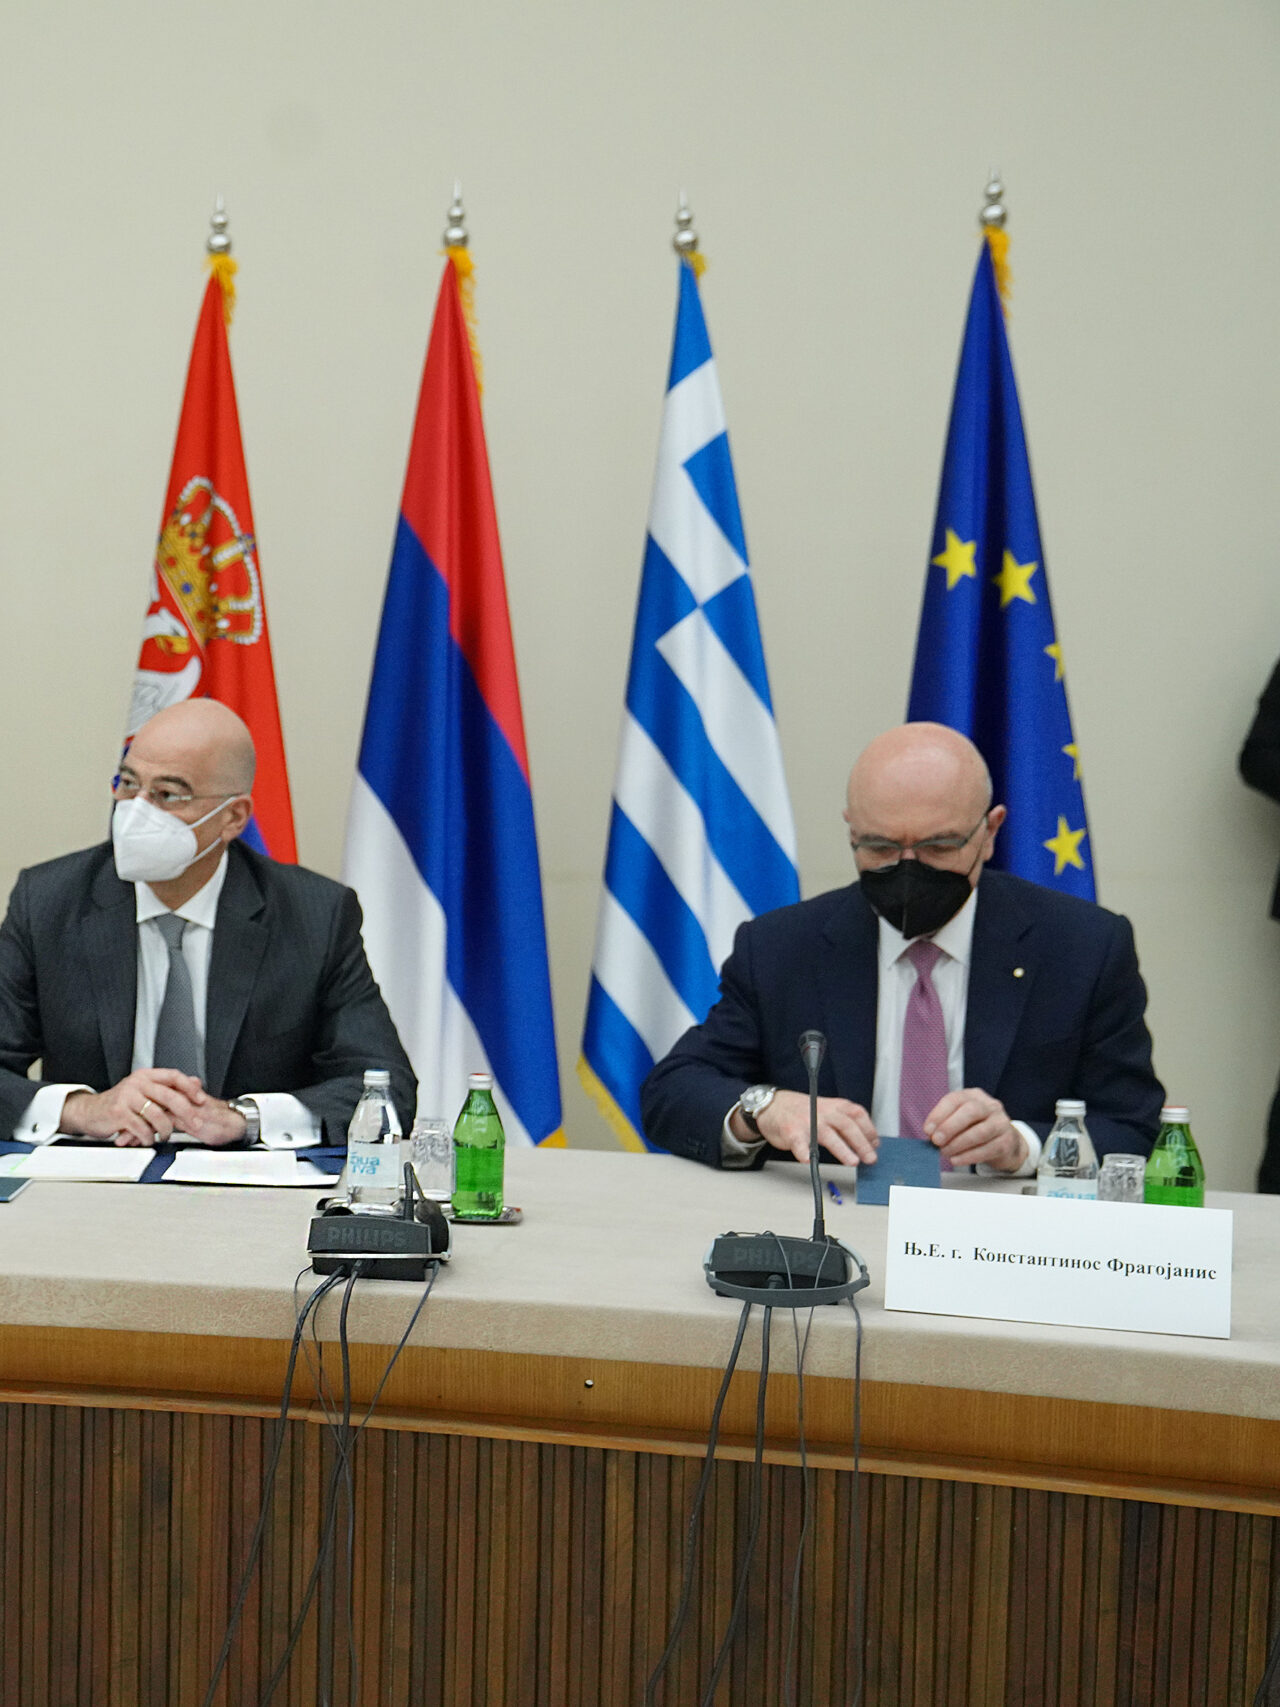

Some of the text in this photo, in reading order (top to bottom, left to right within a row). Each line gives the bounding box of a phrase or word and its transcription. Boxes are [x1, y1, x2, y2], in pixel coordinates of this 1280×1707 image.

[327, 1225, 408, 1248] PHILIPS
[904, 1241, 1218, 1281] Њ.Е. г. Константинос Фрагојанис
